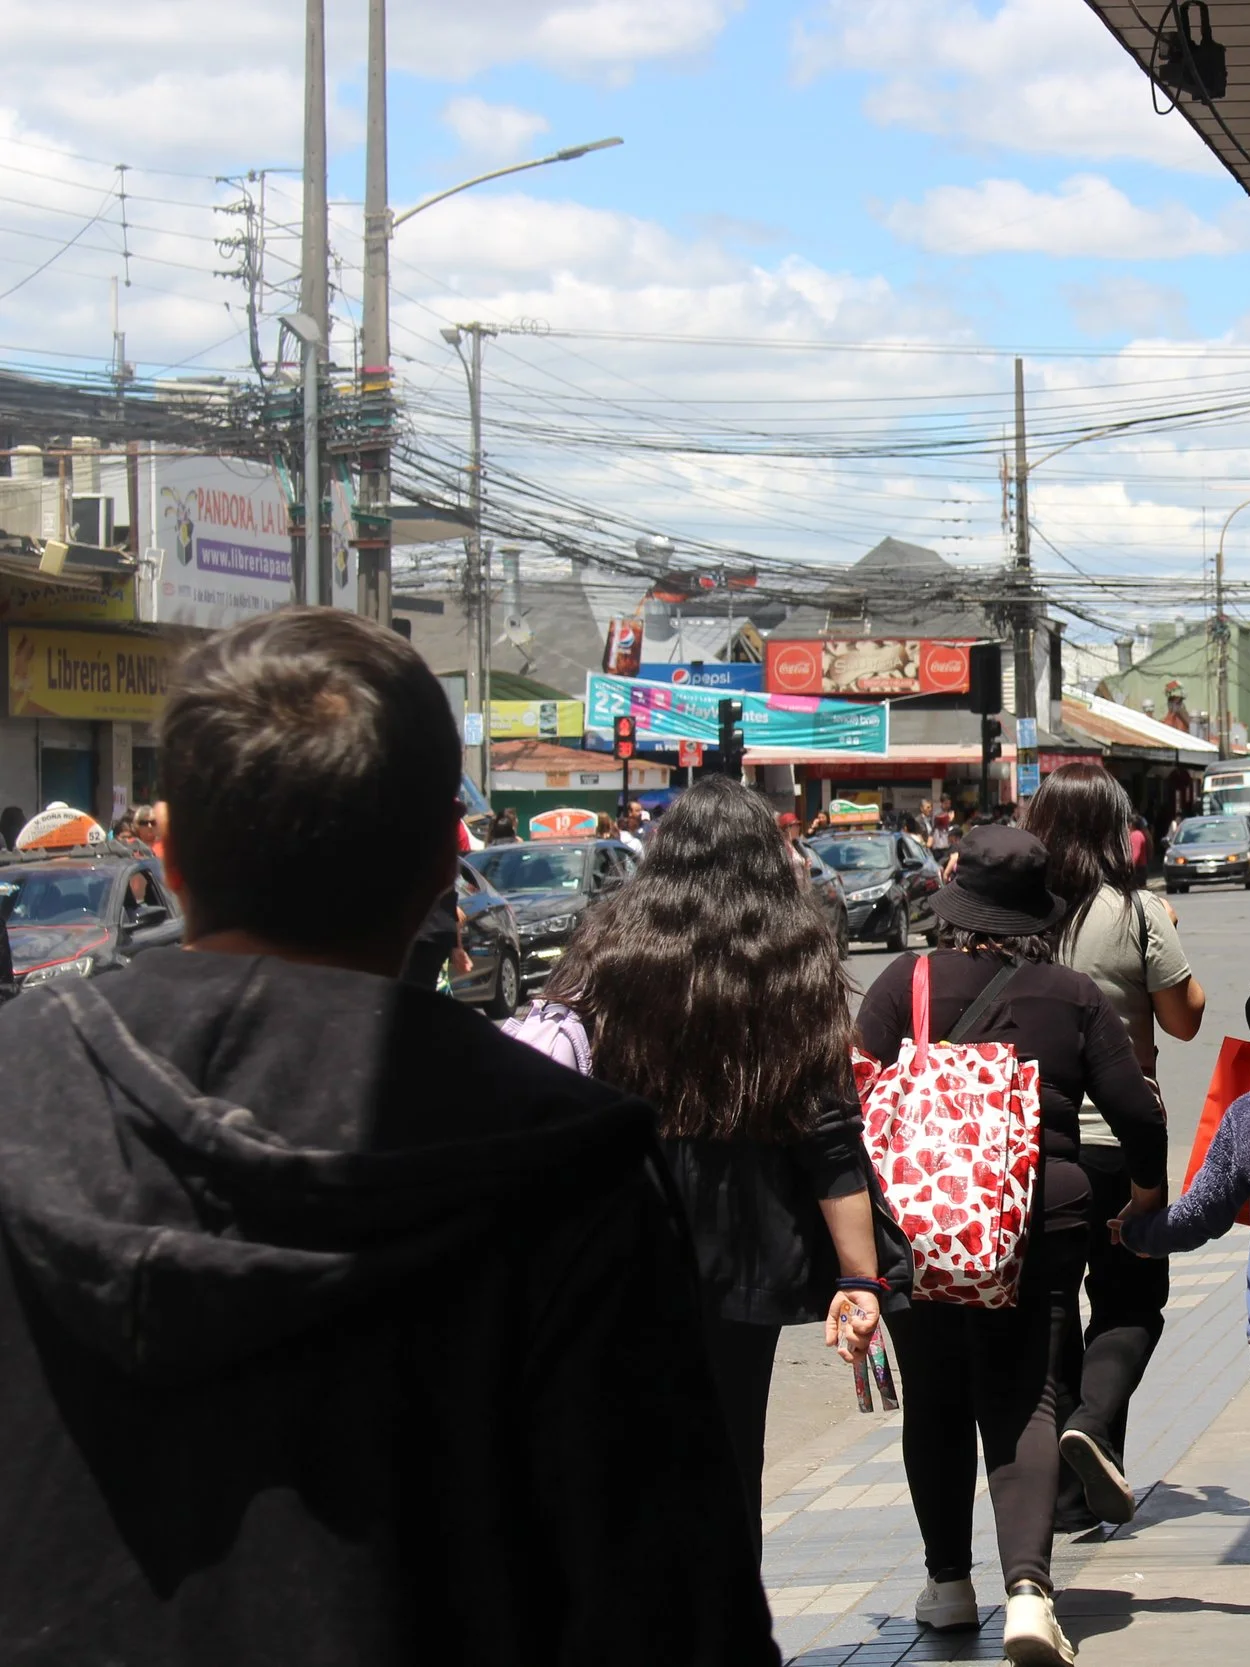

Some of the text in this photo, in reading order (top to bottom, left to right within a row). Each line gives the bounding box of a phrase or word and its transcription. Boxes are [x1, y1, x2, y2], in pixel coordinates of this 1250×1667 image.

[197, 487, 258, 537] PANDORA,
[260, 500, 275, 535] LA
[47, 646, 111, 693] Librería
[692, 671, 731, 686] pepsi
[594, 691, 625, 715] 22
[88, 831, 101, 841] 52
